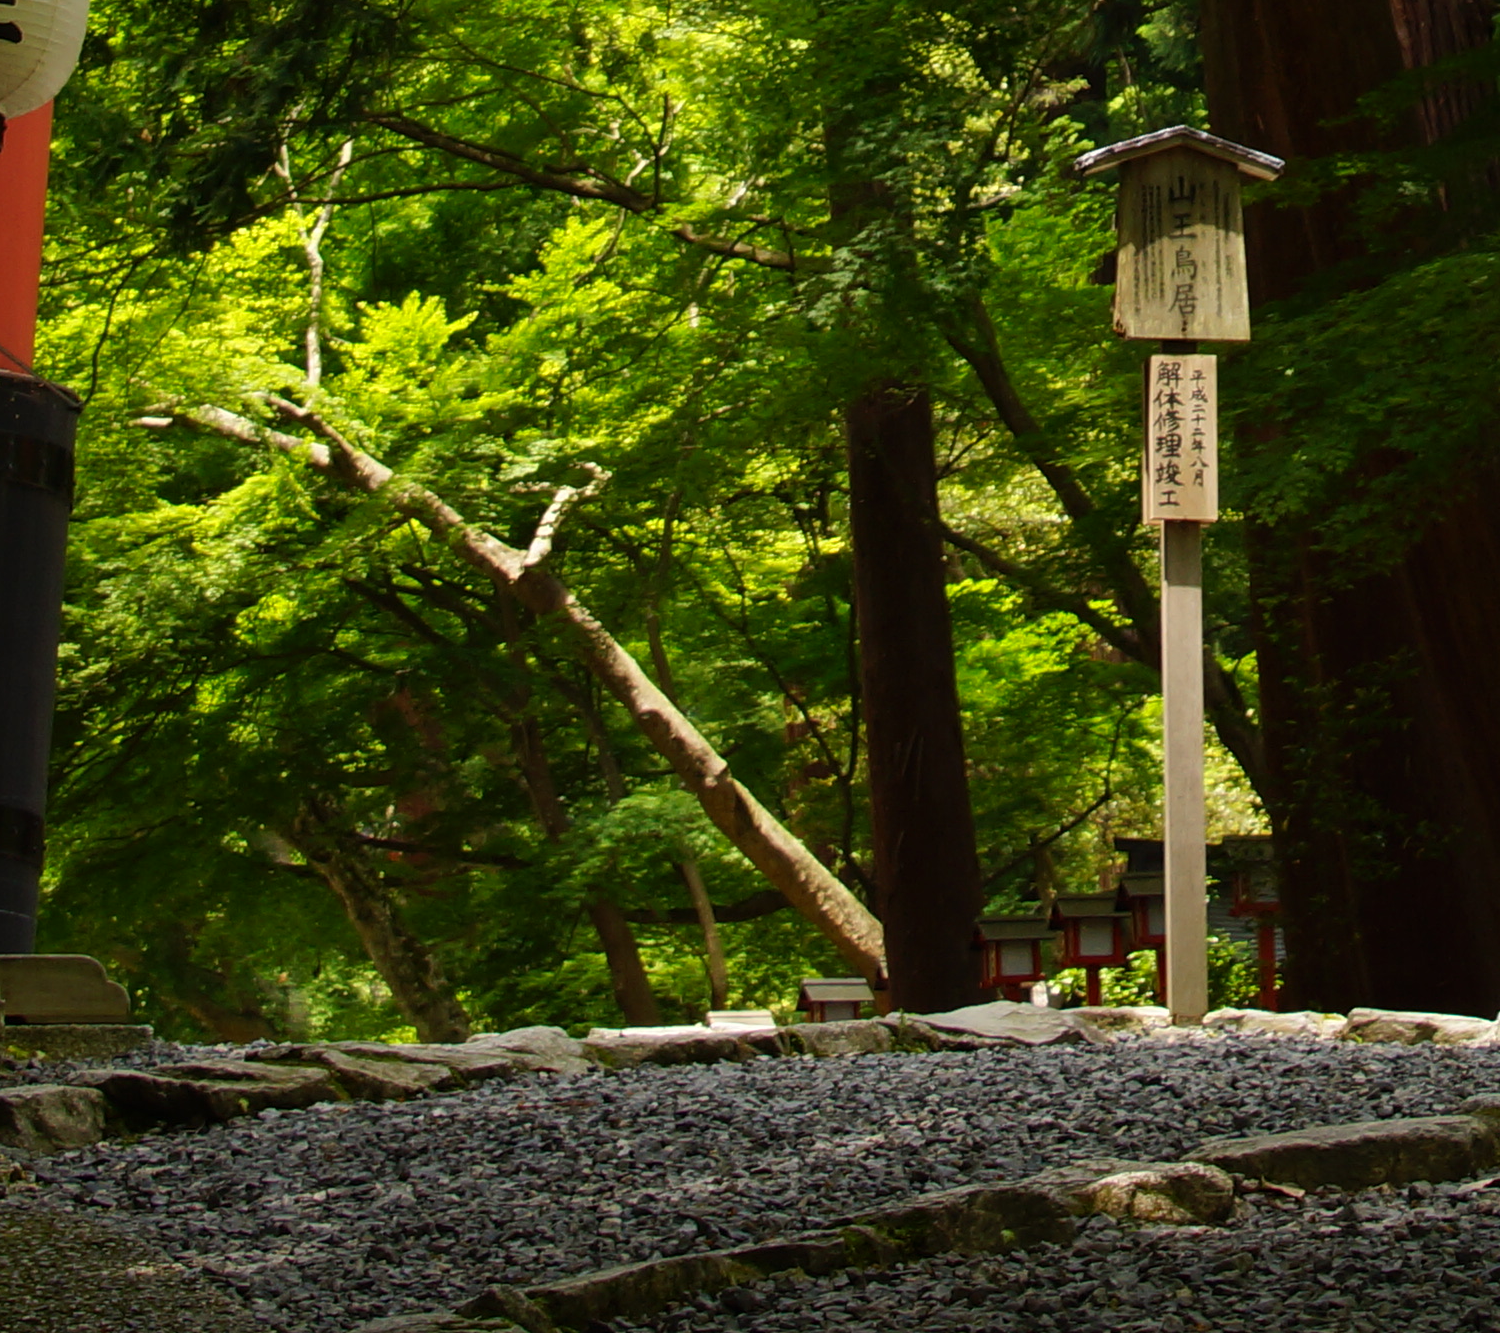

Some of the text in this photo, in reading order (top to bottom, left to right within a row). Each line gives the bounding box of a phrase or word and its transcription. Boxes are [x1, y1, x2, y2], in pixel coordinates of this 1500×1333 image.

[1167, 176, 1199, 317] 山王鳥居
[1152, 360, 1185, 507] 解体修理竣工
[1189, 369, 1209, 488] 平成二十二年八月
